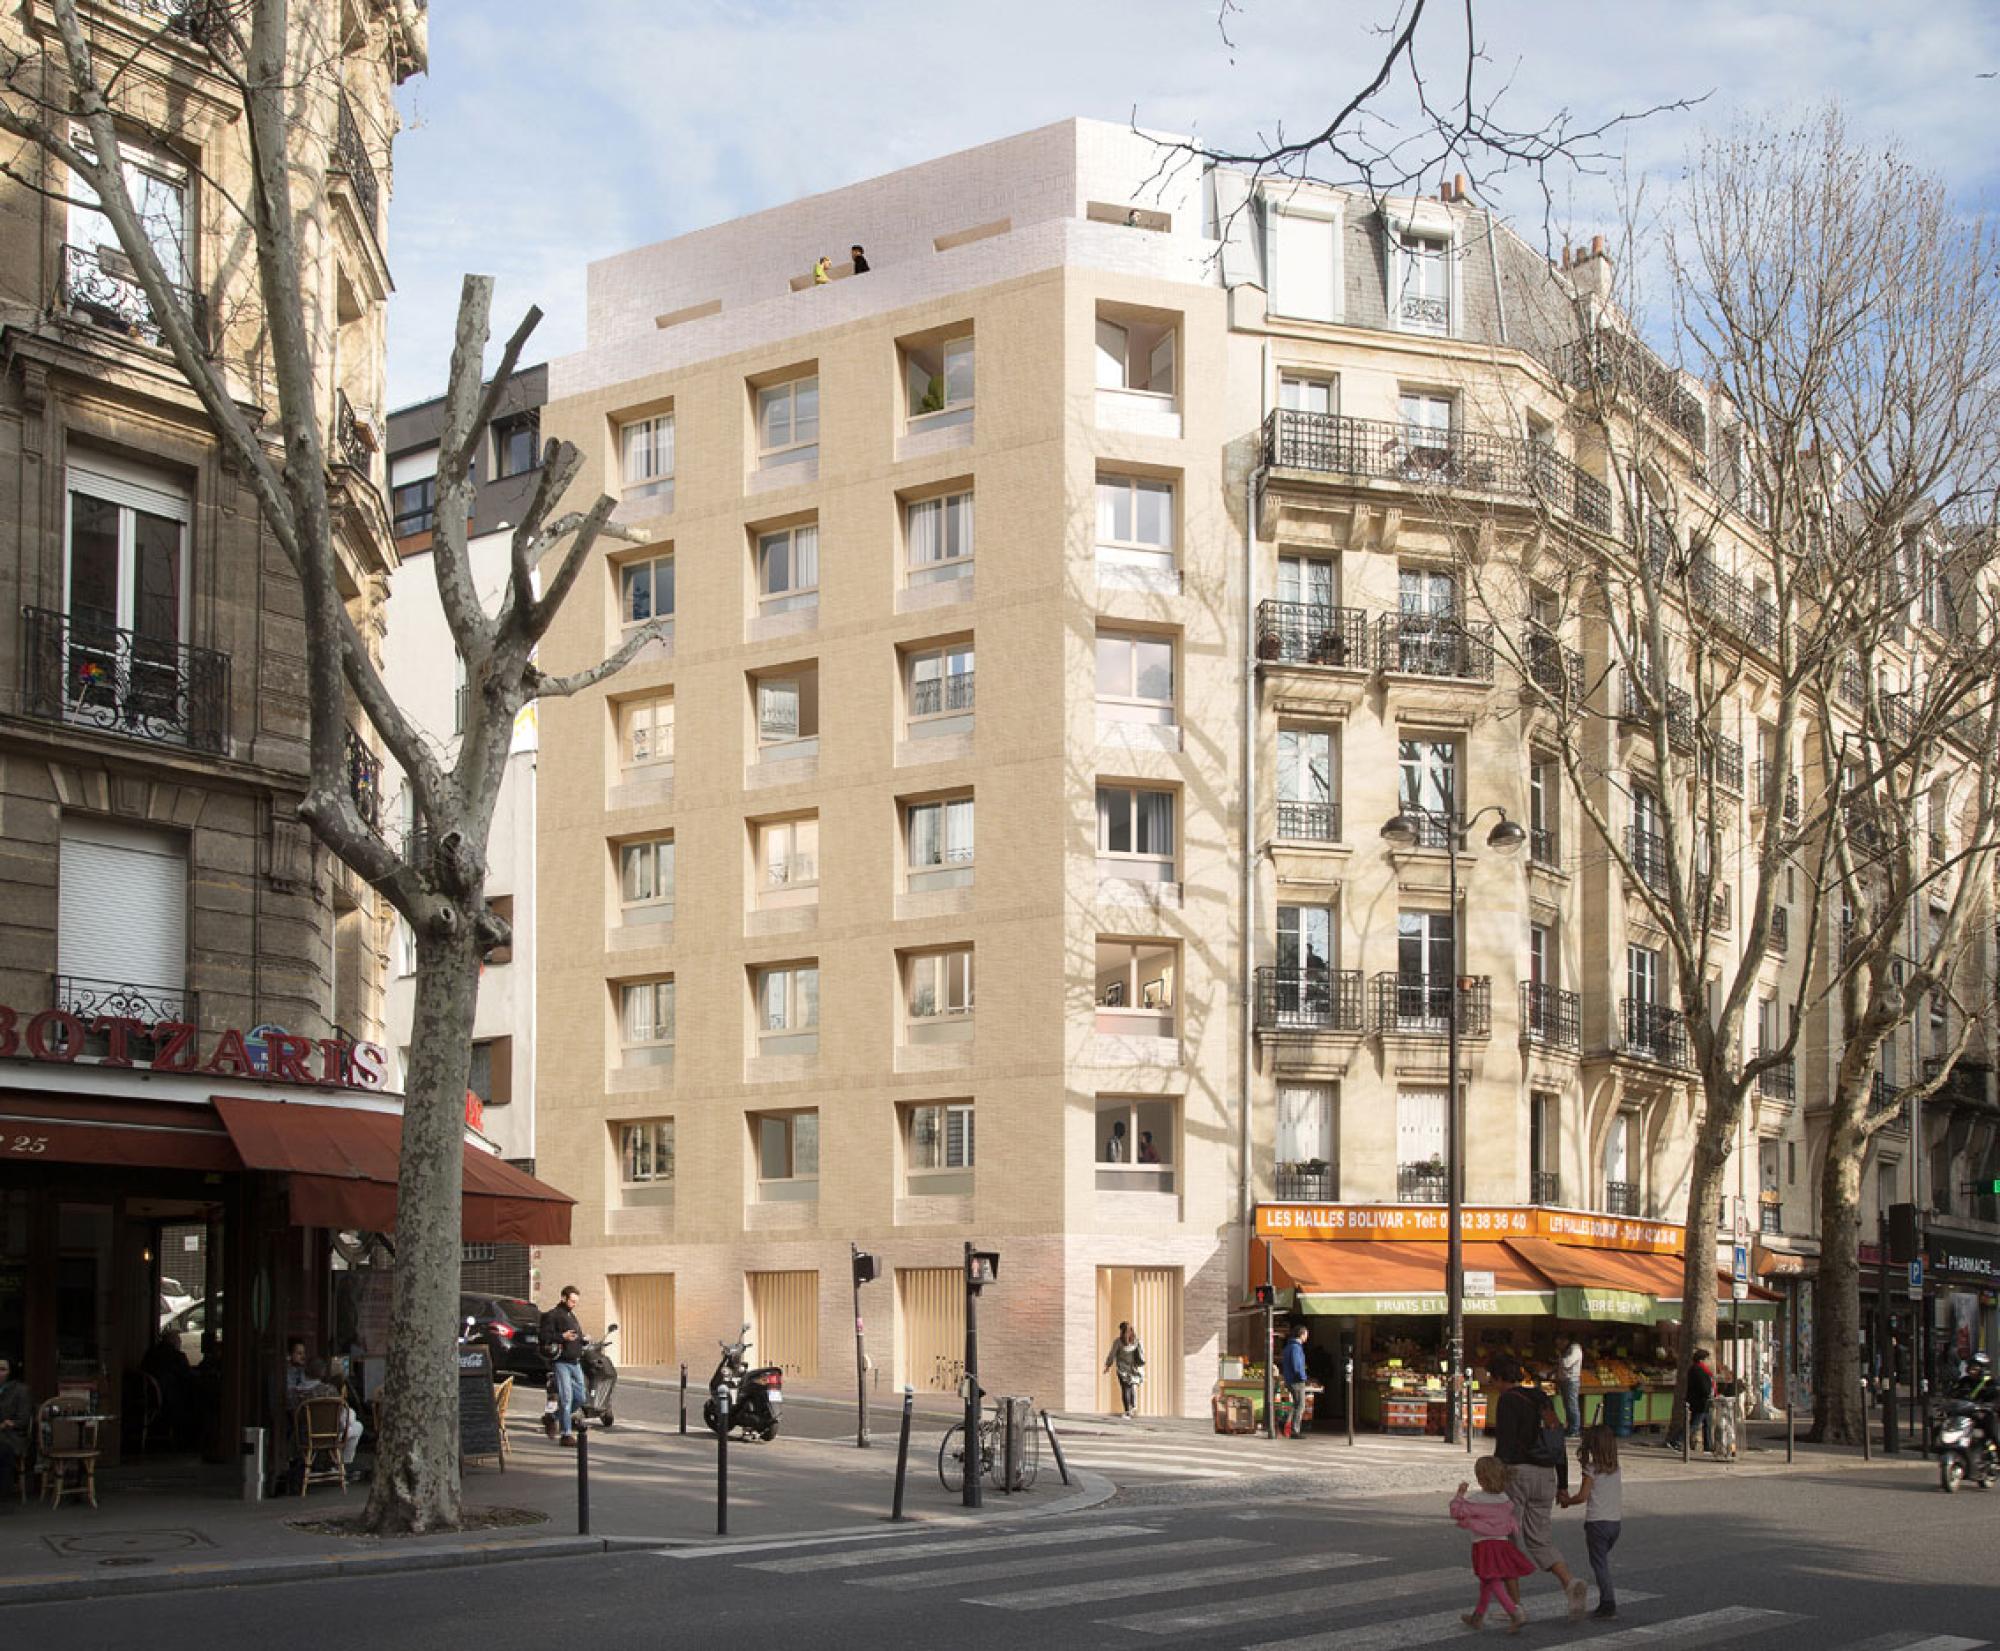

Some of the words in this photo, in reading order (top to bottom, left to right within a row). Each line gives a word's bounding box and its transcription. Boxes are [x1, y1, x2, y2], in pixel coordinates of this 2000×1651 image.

[11, 1135, 48, 1153] 25
[1267, 1210, 1292, 1227] LES
[1295, 1210, 1345, 1227] HALLES
[1348, 1211, 1405, 1228] BOLIVAR
[1376, 1299, 1419, 1312] FRUITS
[1421, 1299, 1438, 1312] ET
[1440, 1299, 1498, 1312] LUMES
